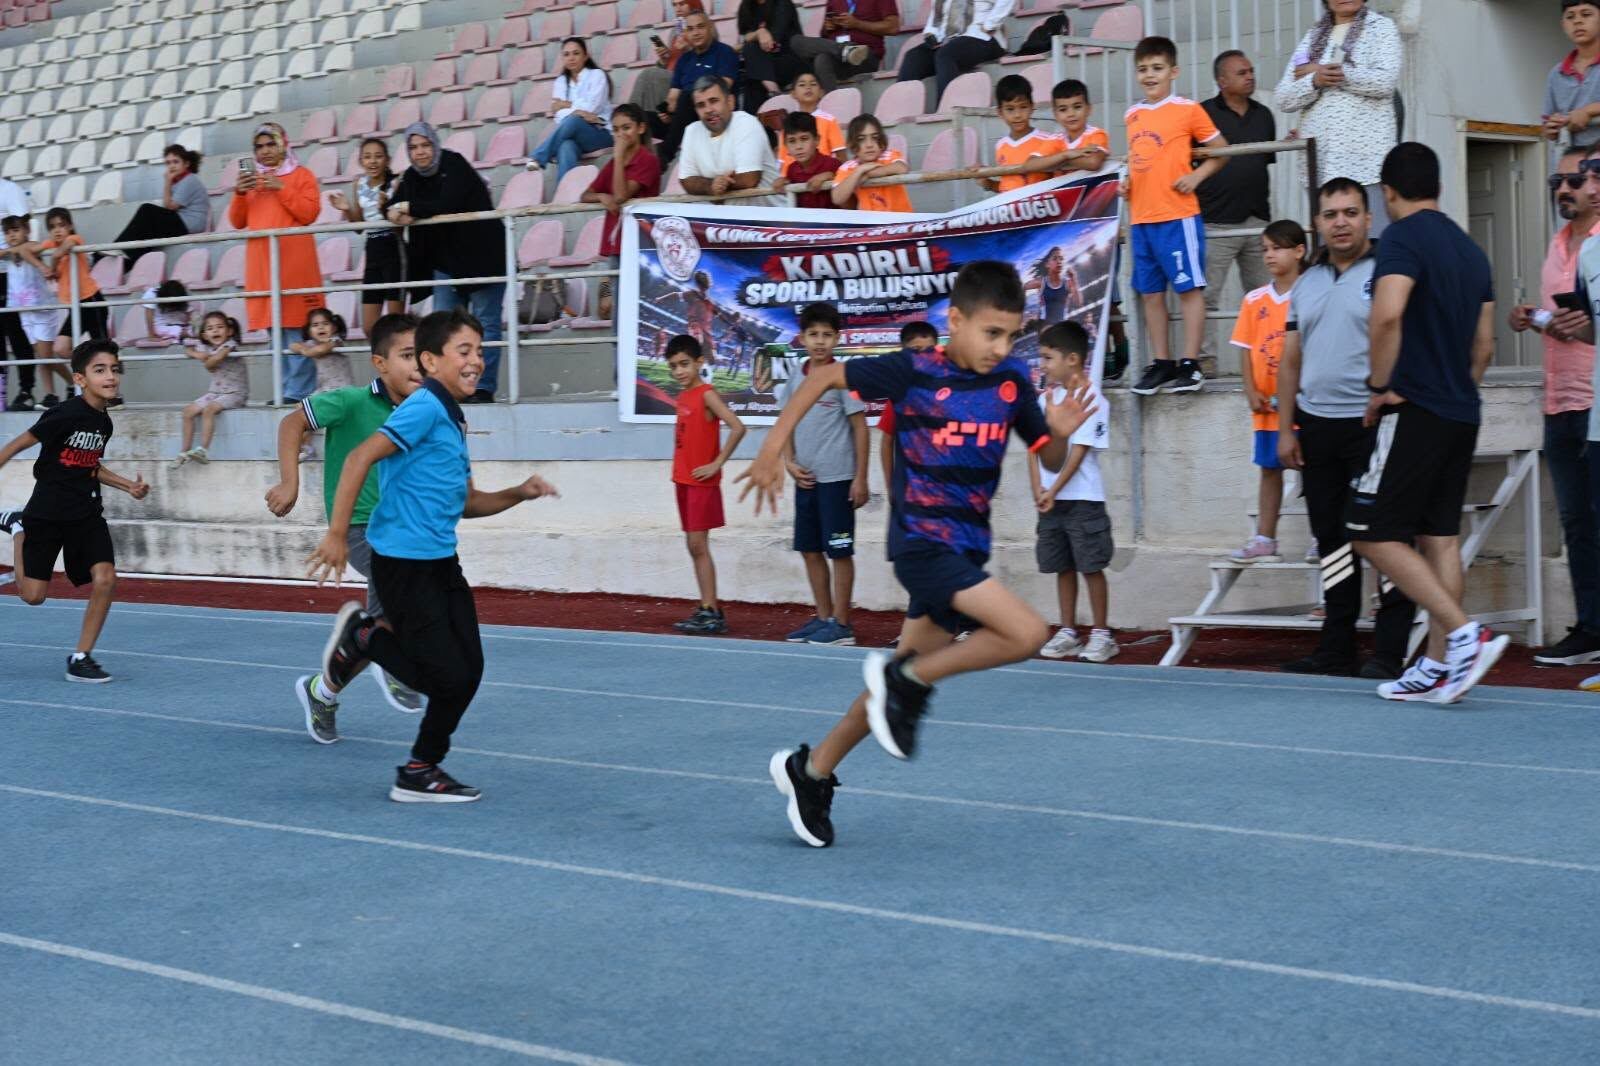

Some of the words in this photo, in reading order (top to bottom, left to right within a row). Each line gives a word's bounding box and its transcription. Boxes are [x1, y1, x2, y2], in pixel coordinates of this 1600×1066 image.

[780, 240, 934, 281] KADİRLİ
[745, 279, 840, 305] SPORLA
[843, 271, 958, 300] BULUŞUYO
[849, 331, 902, 344] SPONSOR
